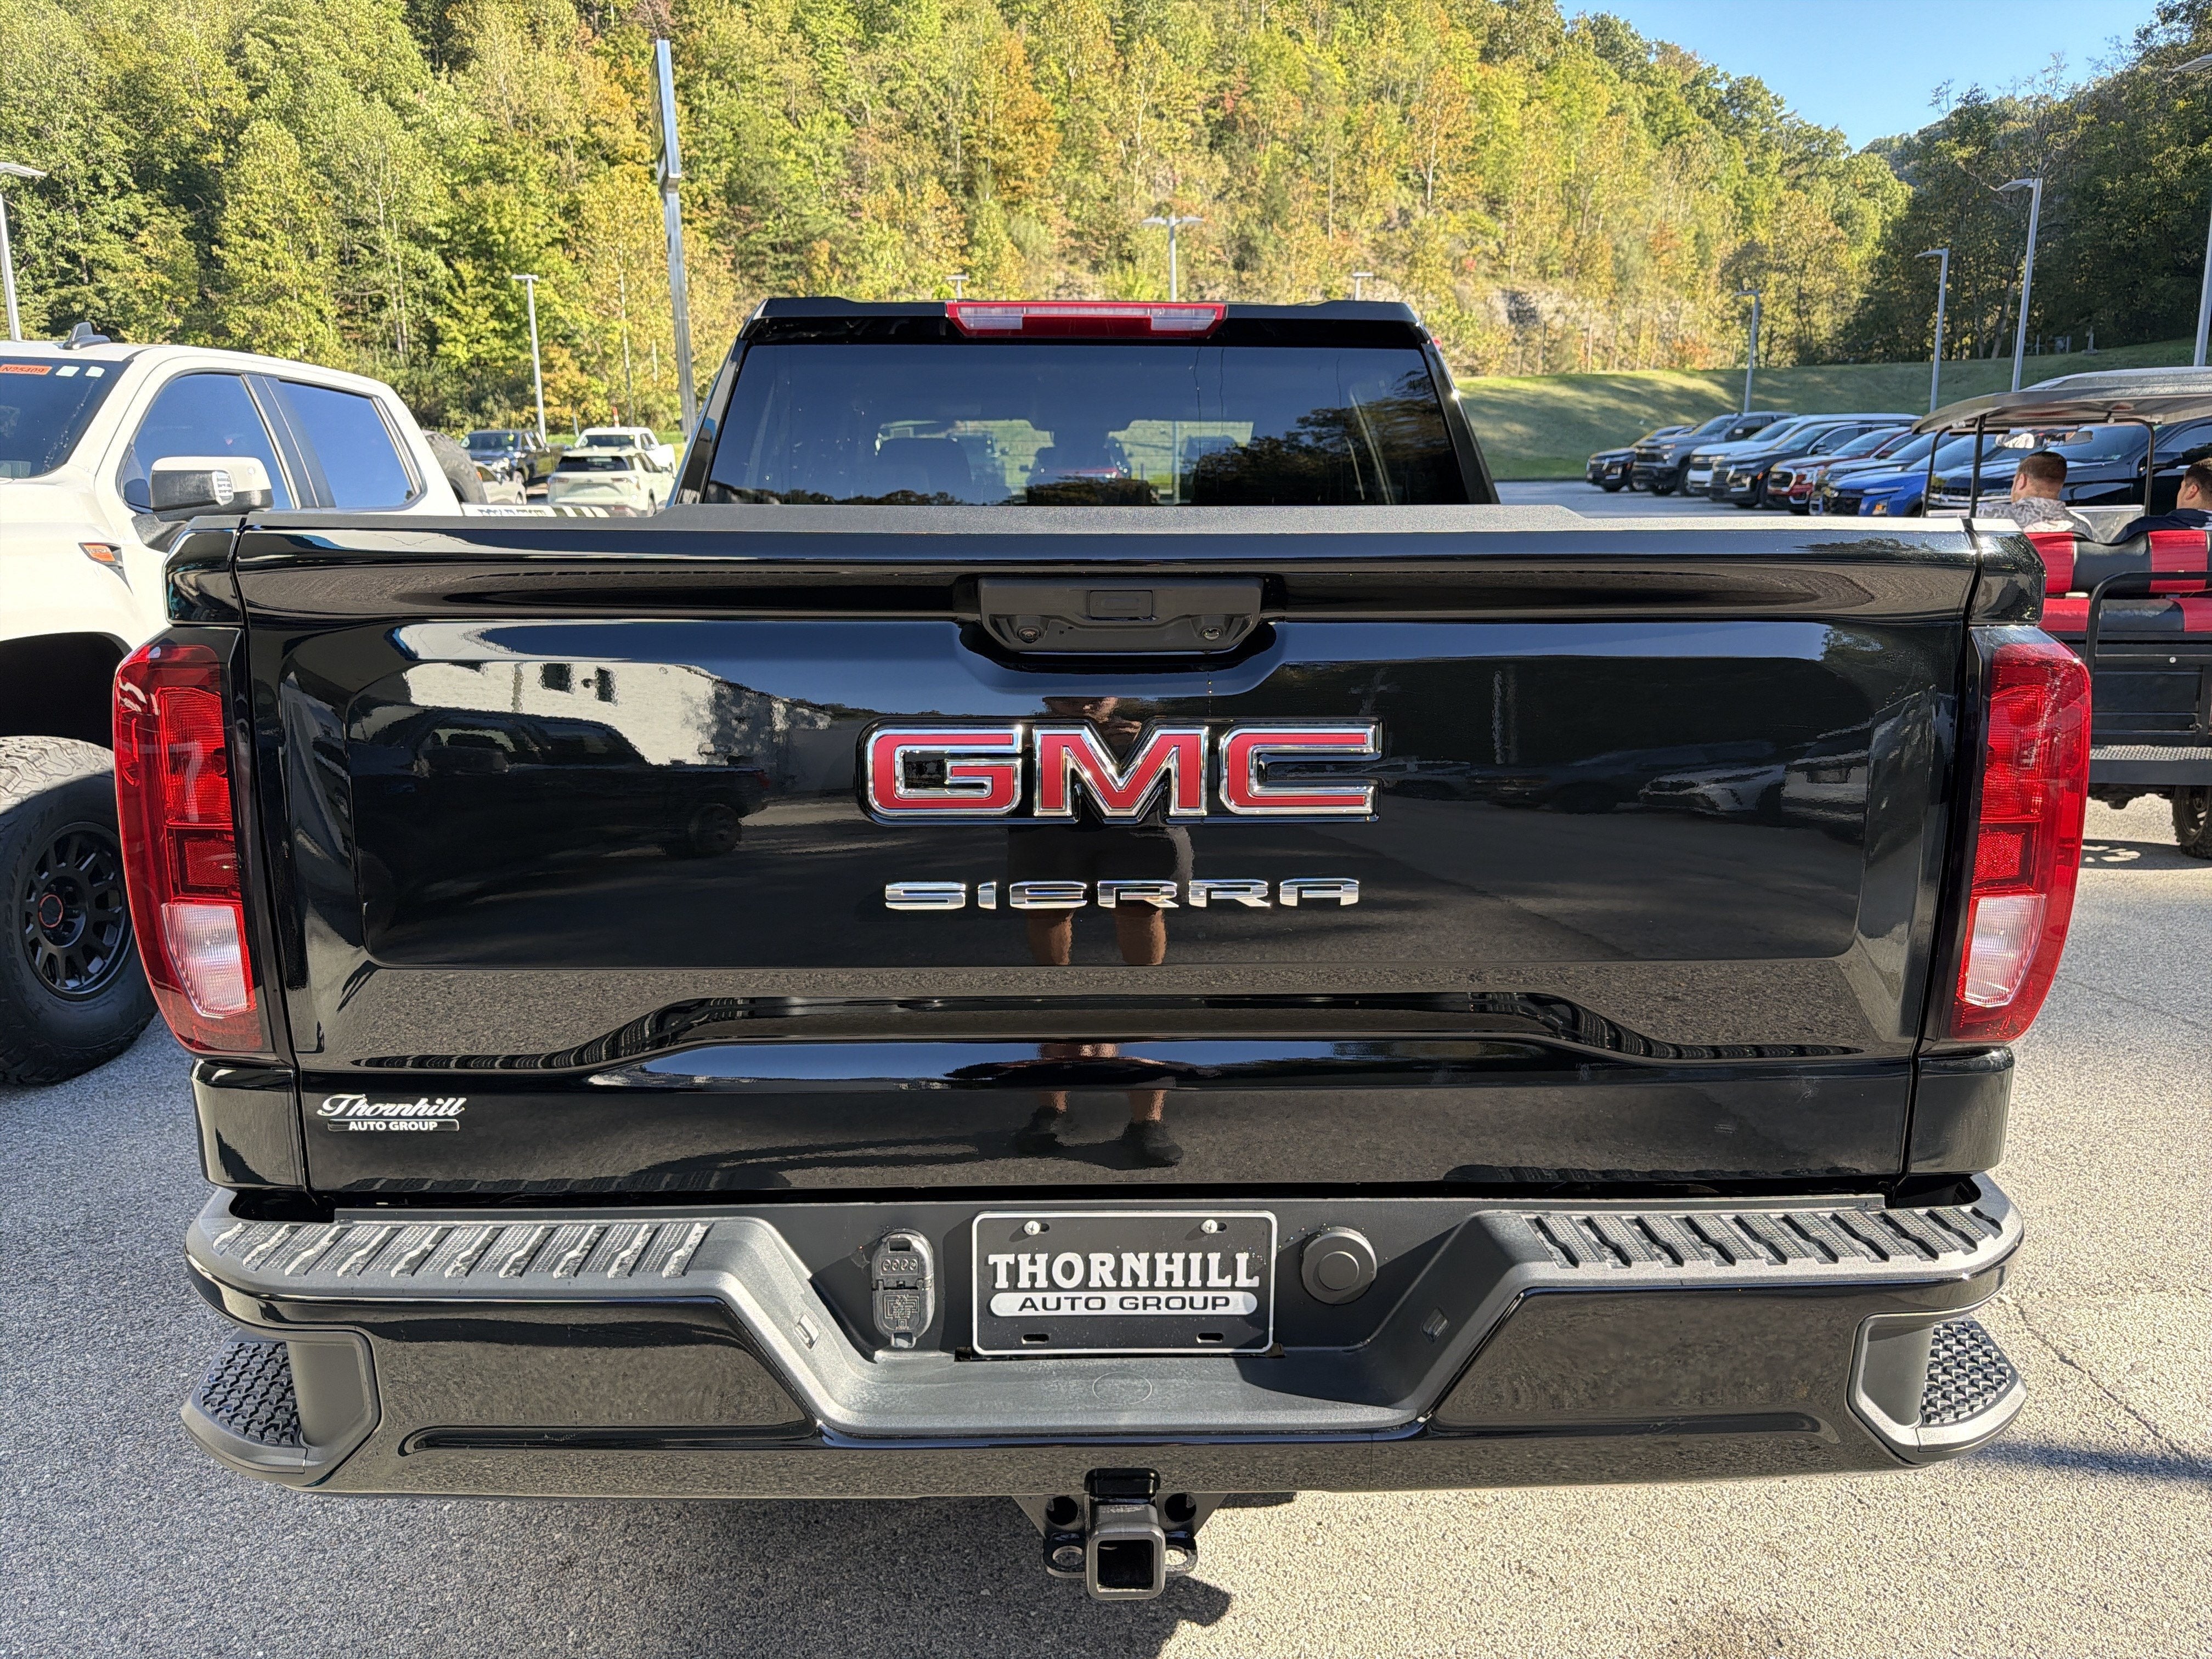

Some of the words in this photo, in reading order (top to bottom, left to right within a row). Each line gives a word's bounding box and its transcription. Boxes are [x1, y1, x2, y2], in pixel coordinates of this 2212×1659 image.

[867, 724, 1383, 817] GMC
[884, 879, 1361, 910] SIERRA
[317, 1093, 467, 1116] Thornhill
[348, 1121, 386, 1131] AUTO
[389, 1121, 438, 1131] GROUP
[988, 1252, 1260, 1289] THORNHILL
[1018, 1296, 1106, 1312] AUTO
[1119, 1295, 1230, 1311] GROUP
